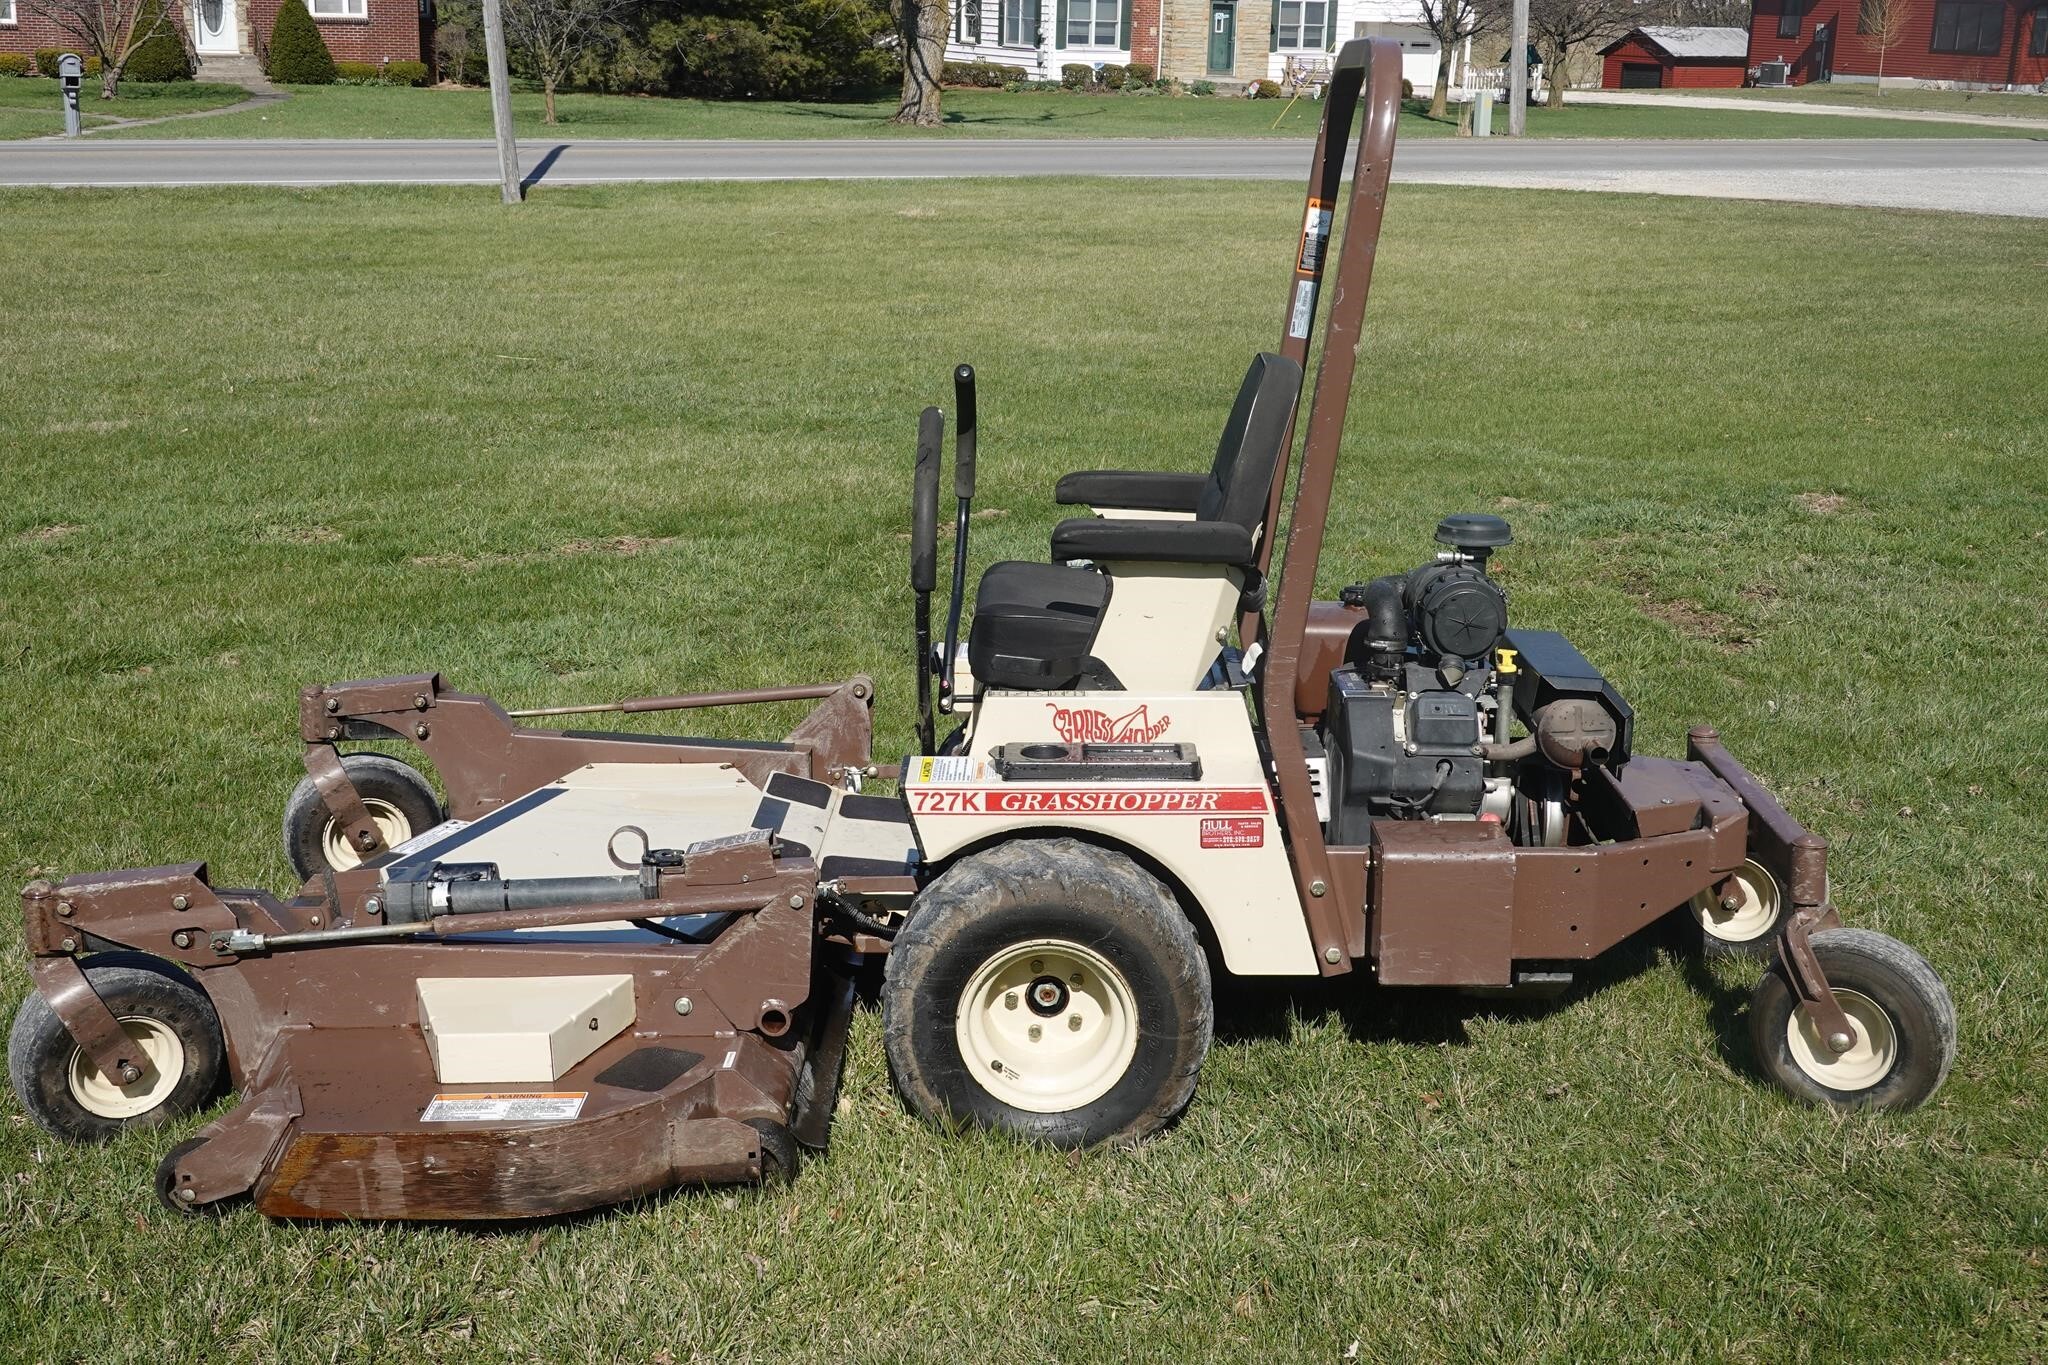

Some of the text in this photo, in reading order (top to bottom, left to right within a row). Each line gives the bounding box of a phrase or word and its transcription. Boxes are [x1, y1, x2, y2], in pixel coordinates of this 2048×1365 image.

[914, 792, 980, 812] 727K
[1001, 792, 1219, 811] GRASSHOPPER
[1202, 820, 1232, 830] HULL
